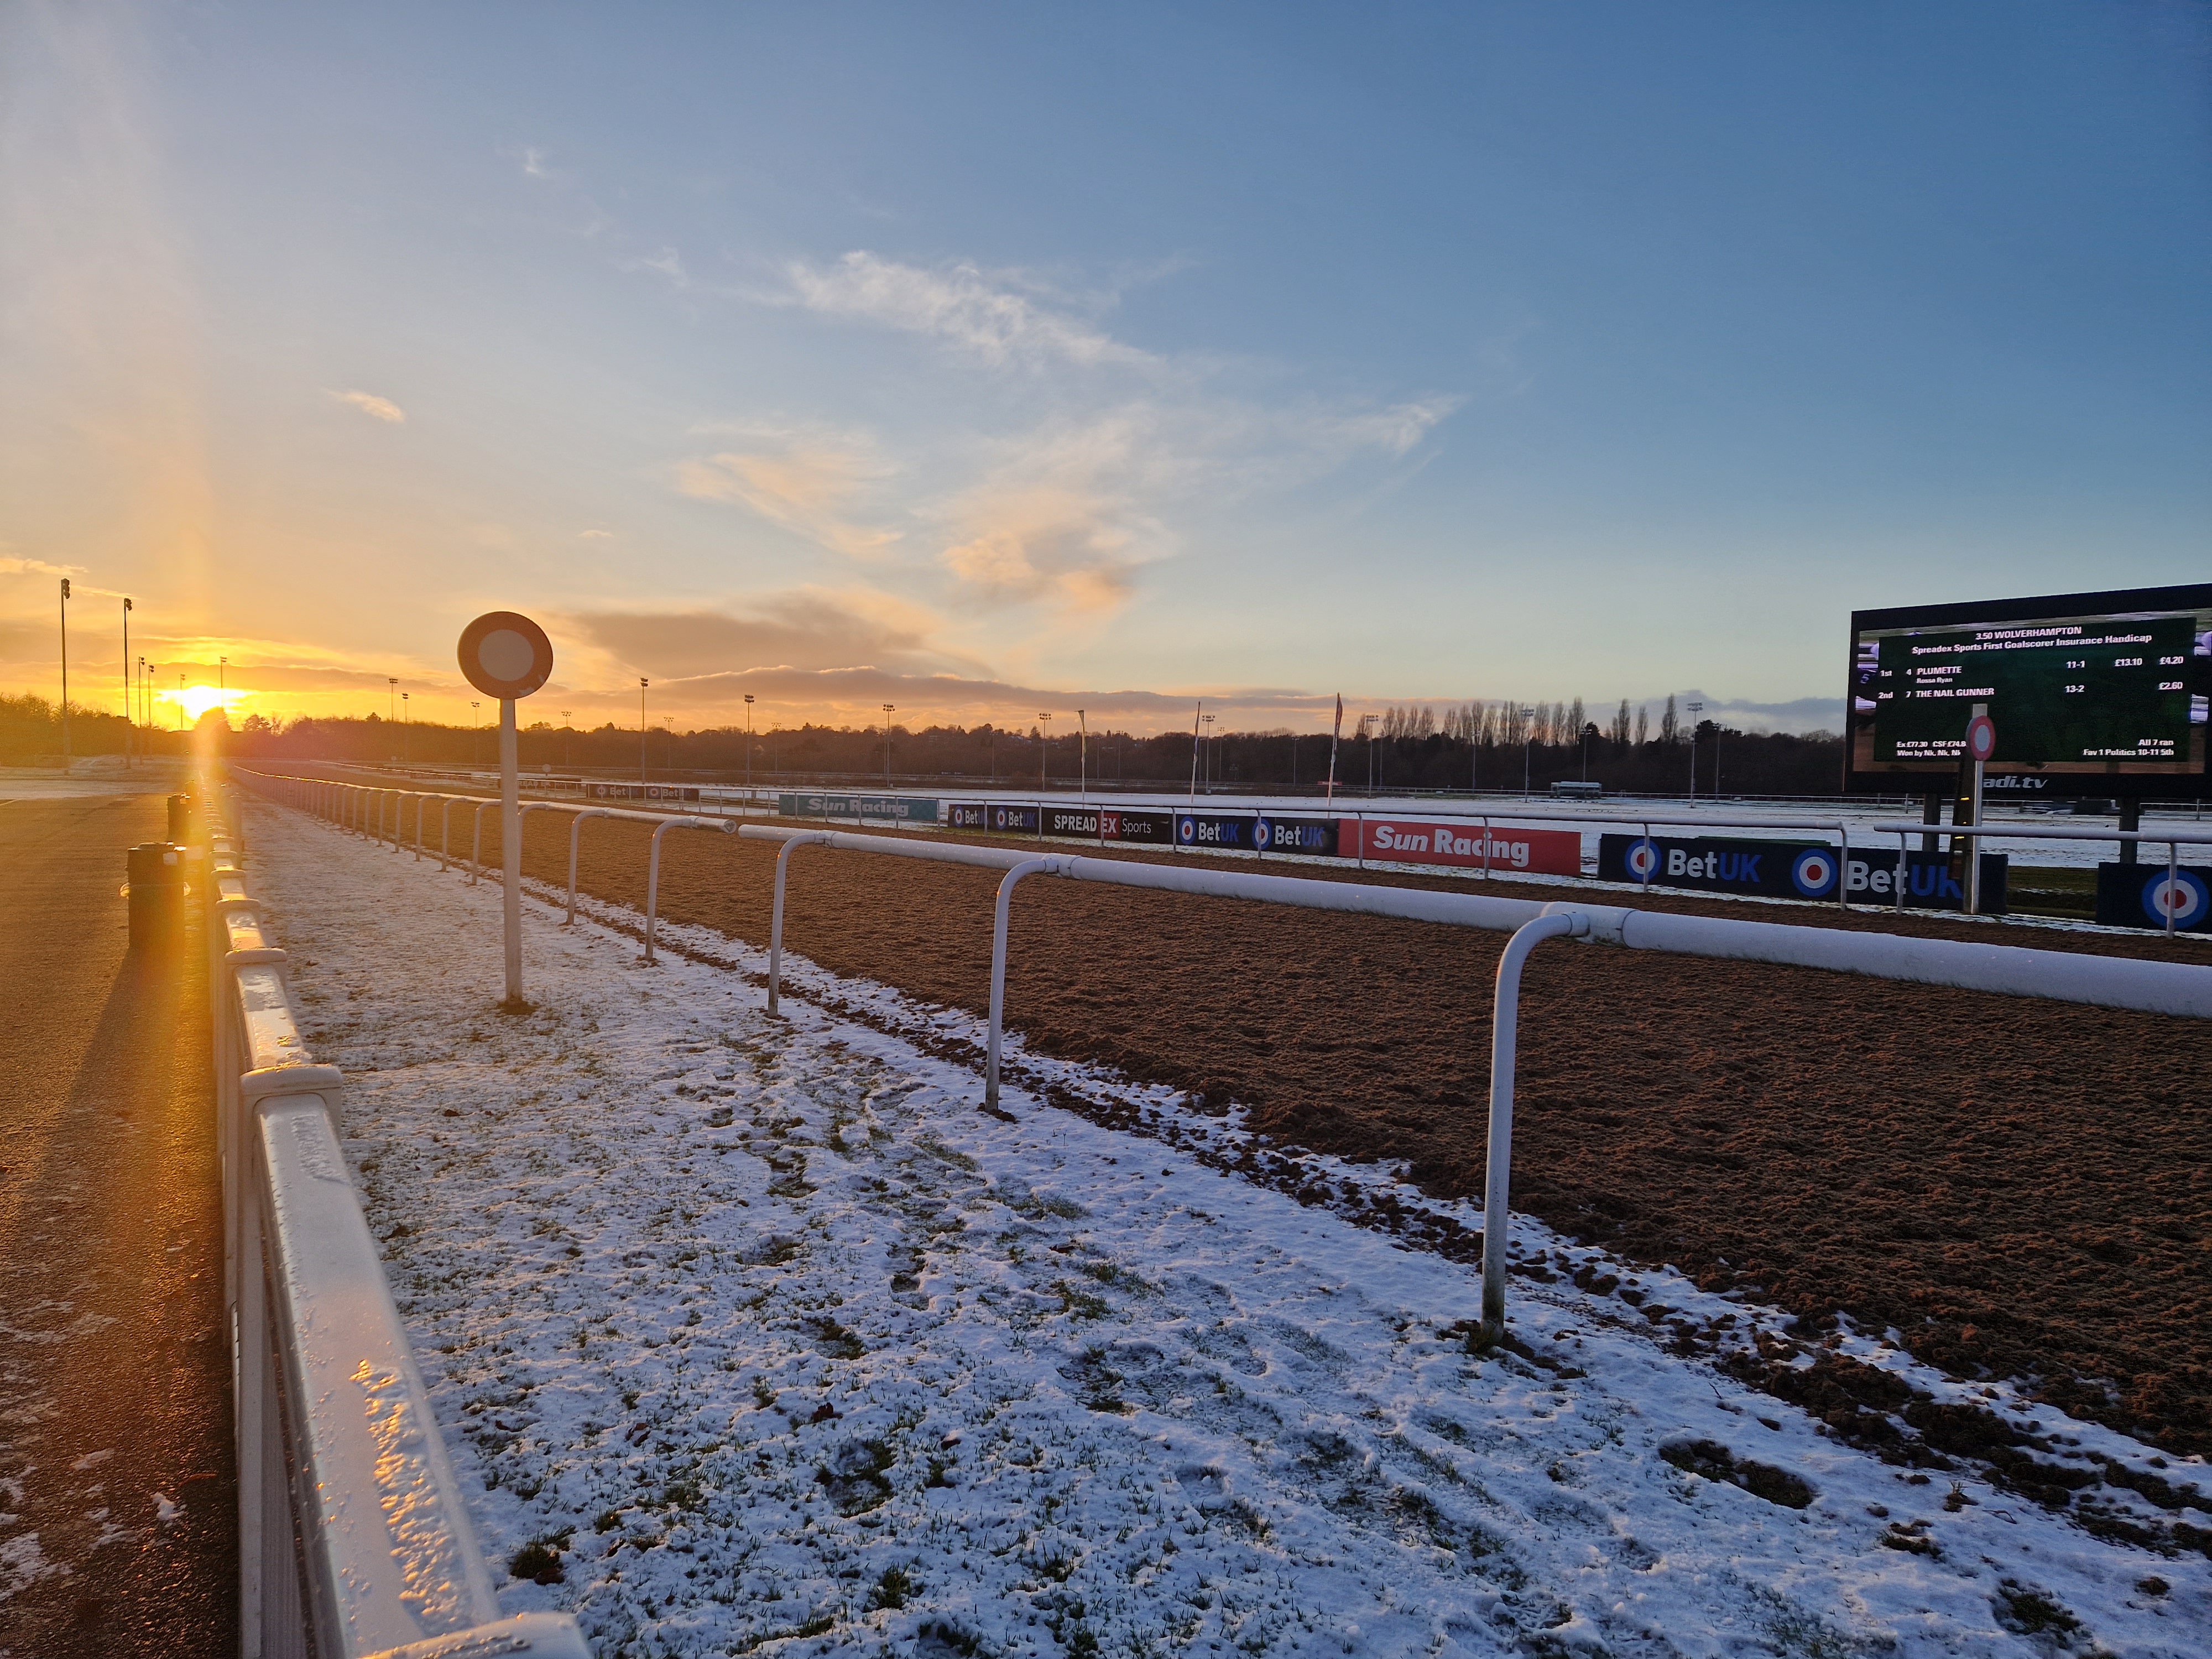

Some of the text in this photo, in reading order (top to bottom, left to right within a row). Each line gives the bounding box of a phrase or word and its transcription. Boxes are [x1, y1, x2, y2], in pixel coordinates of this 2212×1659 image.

[1975, 626, 2082, 640] 3.50 WOLVERHAMPTON
[1911, 634, 2152, 655] Spreadex Sports First Goalscorer Insurance Handicap
[1916, 666, 1963, 675] PLUMETTE
[2066, 660, 2085, 669] 11-1
[2114, 658, 2143, 667] £13.10
[2159, 656, 2184, 665] £4.20
[1915, 690, 1933, 698] THE
[1933, 688, 1955, 697] NAIL
[1955, 687, 1995, 696] GUNNER
[2064, 685, 2085, 693] 13-2
[2158, 682, 2183, 691] £2.60
[1914, 749, 1924, 758] by
[1983, 775, 2049, 789] adi.tv
[807, 797, 909, 817] Sun Racing
[965, 810, 988, 825] BetU
[1008, 811, 1035, 827] BetUK
[1122, 818, 1152, 836] Sports
[1198, 821, 1239, 842] BetUK
[1275, 825, 1325, 847] BetUK
[1373, 826, 1530, 868] Sun Racing
[1667, 849, 1763, 883] BetUK
